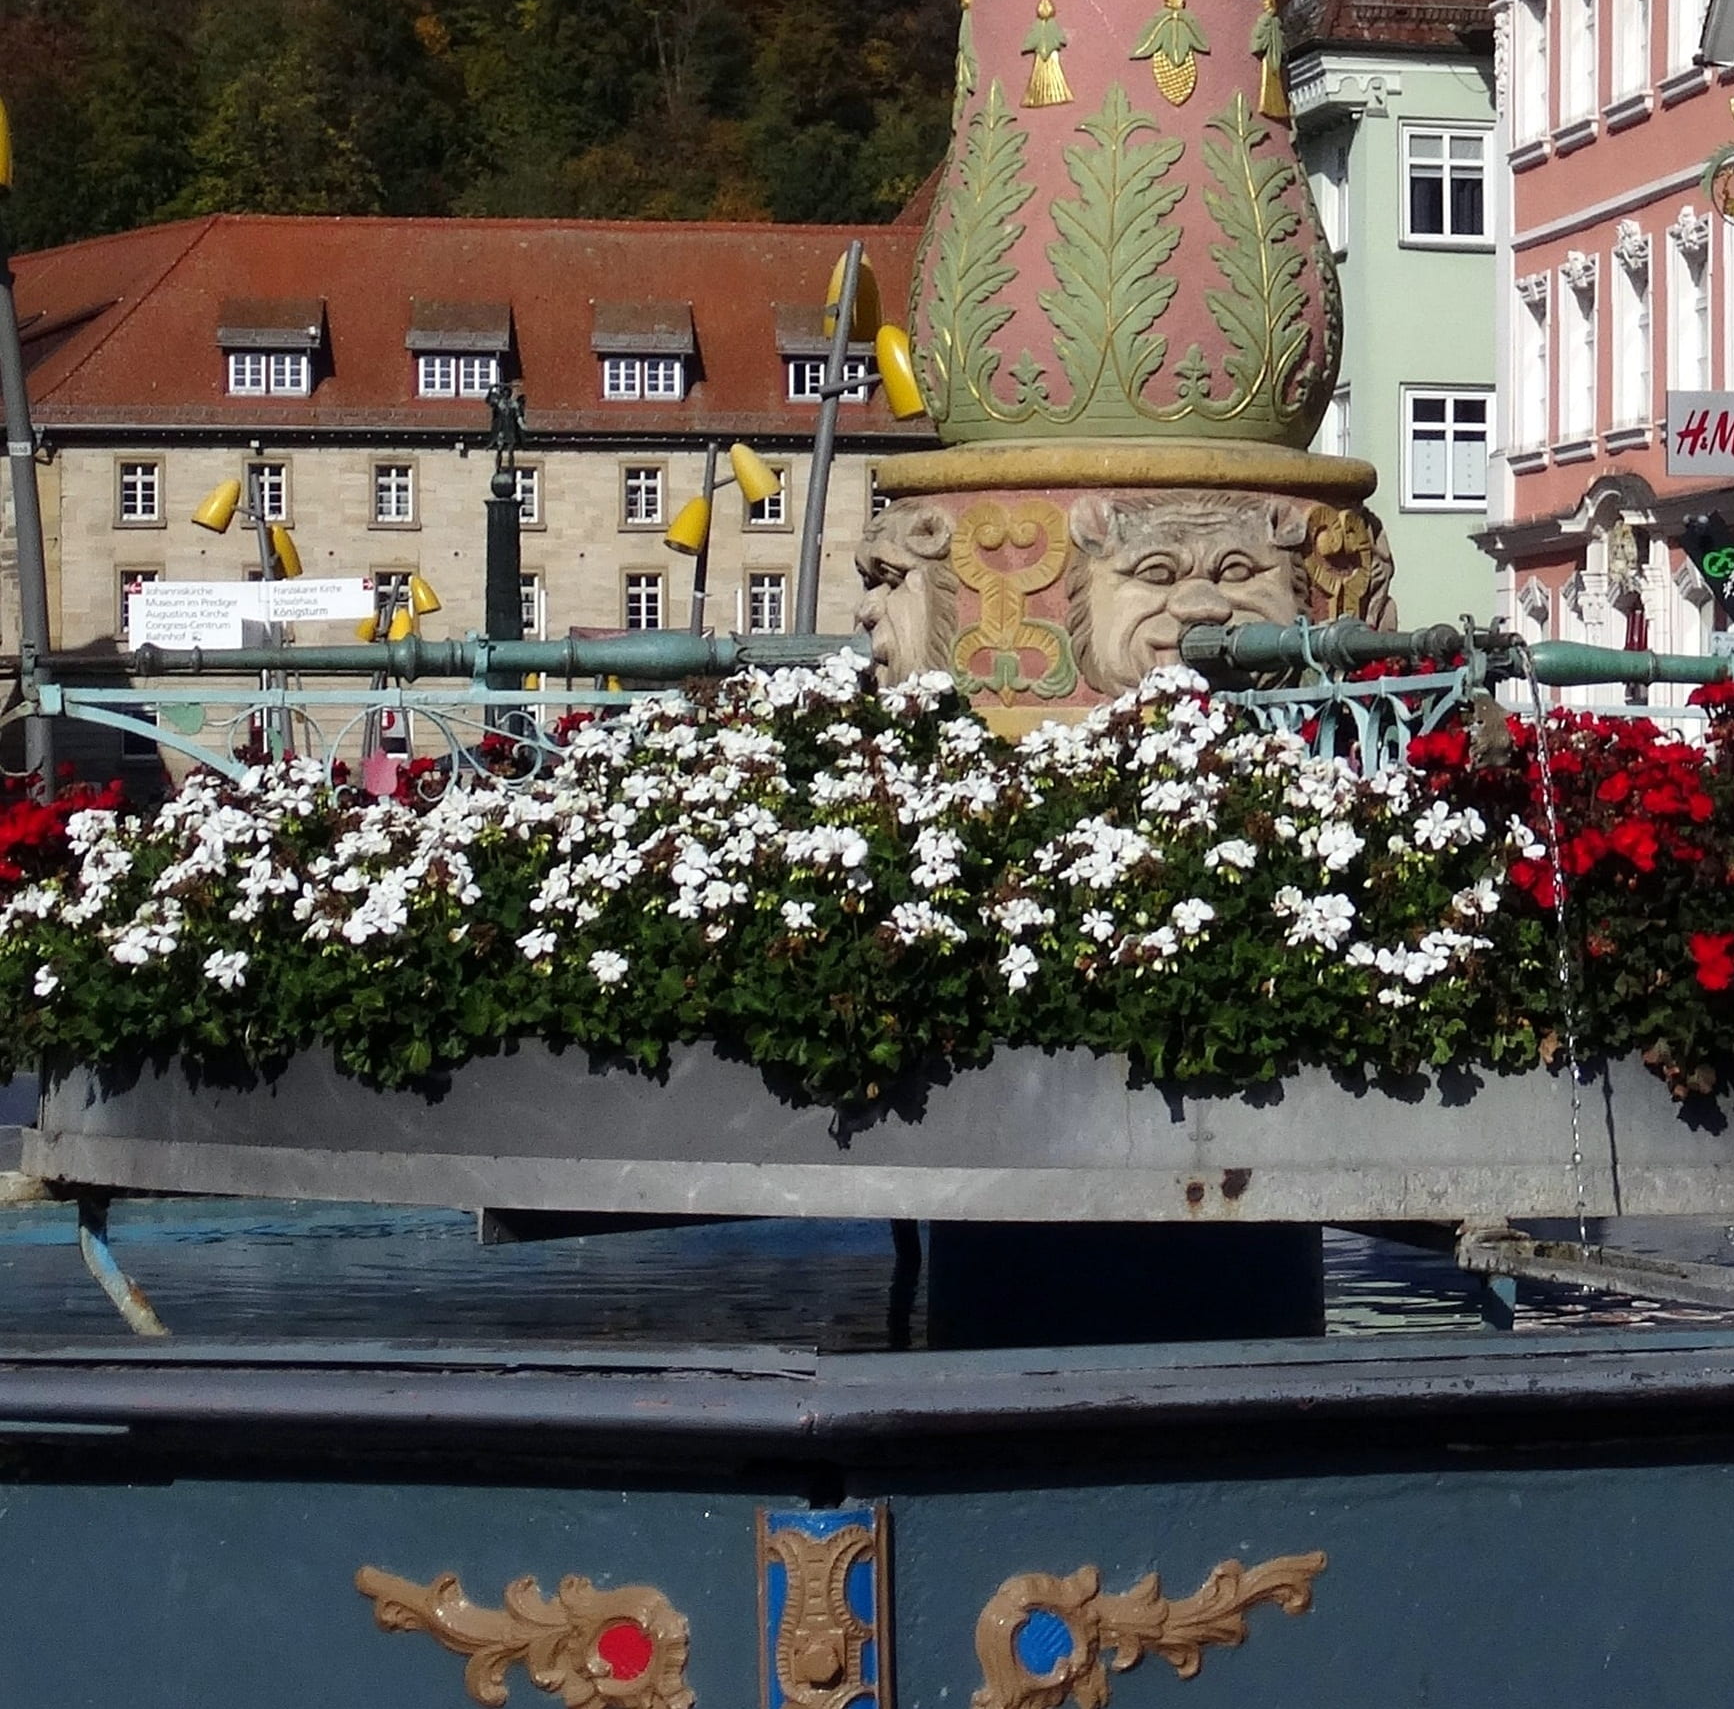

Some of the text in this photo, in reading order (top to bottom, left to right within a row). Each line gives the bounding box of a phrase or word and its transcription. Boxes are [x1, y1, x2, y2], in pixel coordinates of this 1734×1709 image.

[145, 598, 238, 608] Museum im Prediger
[145, 609, 230, 619] Augustinus Kirche
[273, 607, 329, 618] Königsturm
[145, 621, 231, 631] Congress-Centrum
[145, 632, 187, 641] Bahnhof
